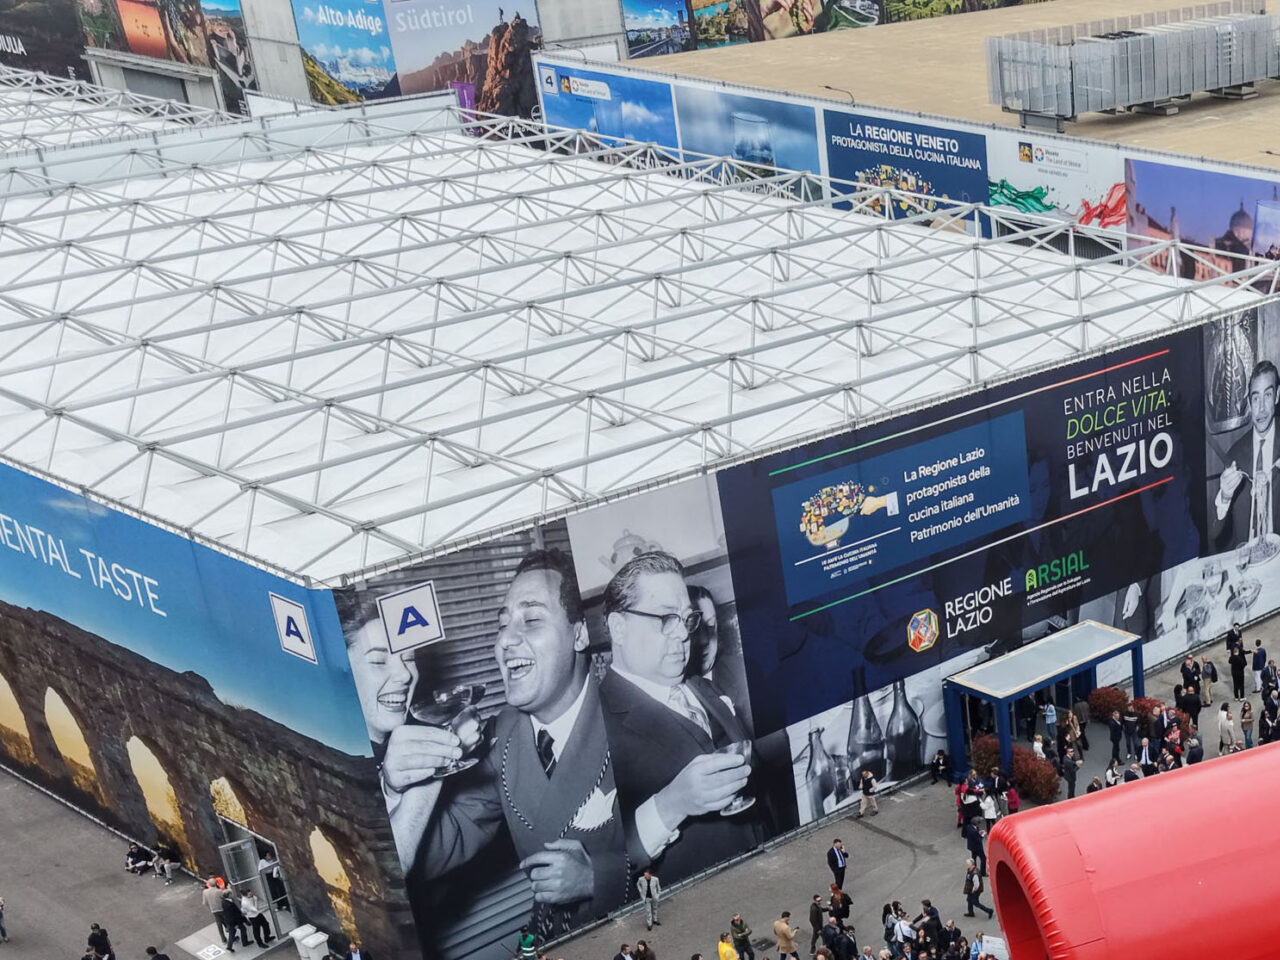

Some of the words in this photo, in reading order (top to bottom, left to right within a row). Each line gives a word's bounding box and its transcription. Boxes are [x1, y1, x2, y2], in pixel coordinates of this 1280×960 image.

[318, 5, 344, 26] Alto
[347, 10, 383, 36] Adige
[396, 5, 475, 33] Südtirol
[544, 75, 554, 88] 4
[831, 135, 888, 155] PROTAGONISTA
[889, 144, 914, 160] DELLA
[914, 149, 946, 165] CUCINA
[946, 155, 982, 170] ITALIANA
[849, 122, 863, 137] LA
[865, 126, 913, 146] REGIONE
[914, 134, 959, 153] VENETO
[1063, 386, 1117, 416] ENTRA
[1122, 367, 1171, 398] NELLA
[1066, 401, 1128, 440] DOLCE
[1131, 389, 1172, 418] VITA:
[1067, 421, 1143, 460] BENVENUTI
[1148, 412, 1173, 432] NEL
[904, 470, 917, 483] La
[918, 457, 958, 478] Regione
[959, 447, 985, 465] Lazio
[1068, 432, 1174, 500] LAZIO
[906, 477, 967, 506] protagonista
[968, 465, 991, 481] della
[908, 506, 940, 524] cucina
[940, 491, 974, 513] italiana
[910, 513, 963, 543] Patrimonio
[963, 494, 1020, 523] dell'Umanità
[0, 513, 82, 579] ENTAL
[79, 547, 167, 617] TASTE
[1025, 550, 1090, 592] ARSIAL
[944, 577, 1013, 619] REGIONE
[285, 615, 306, 645] A
[398, 605, 430, 636] A
[946, 606, 993, 639] LAZIO
